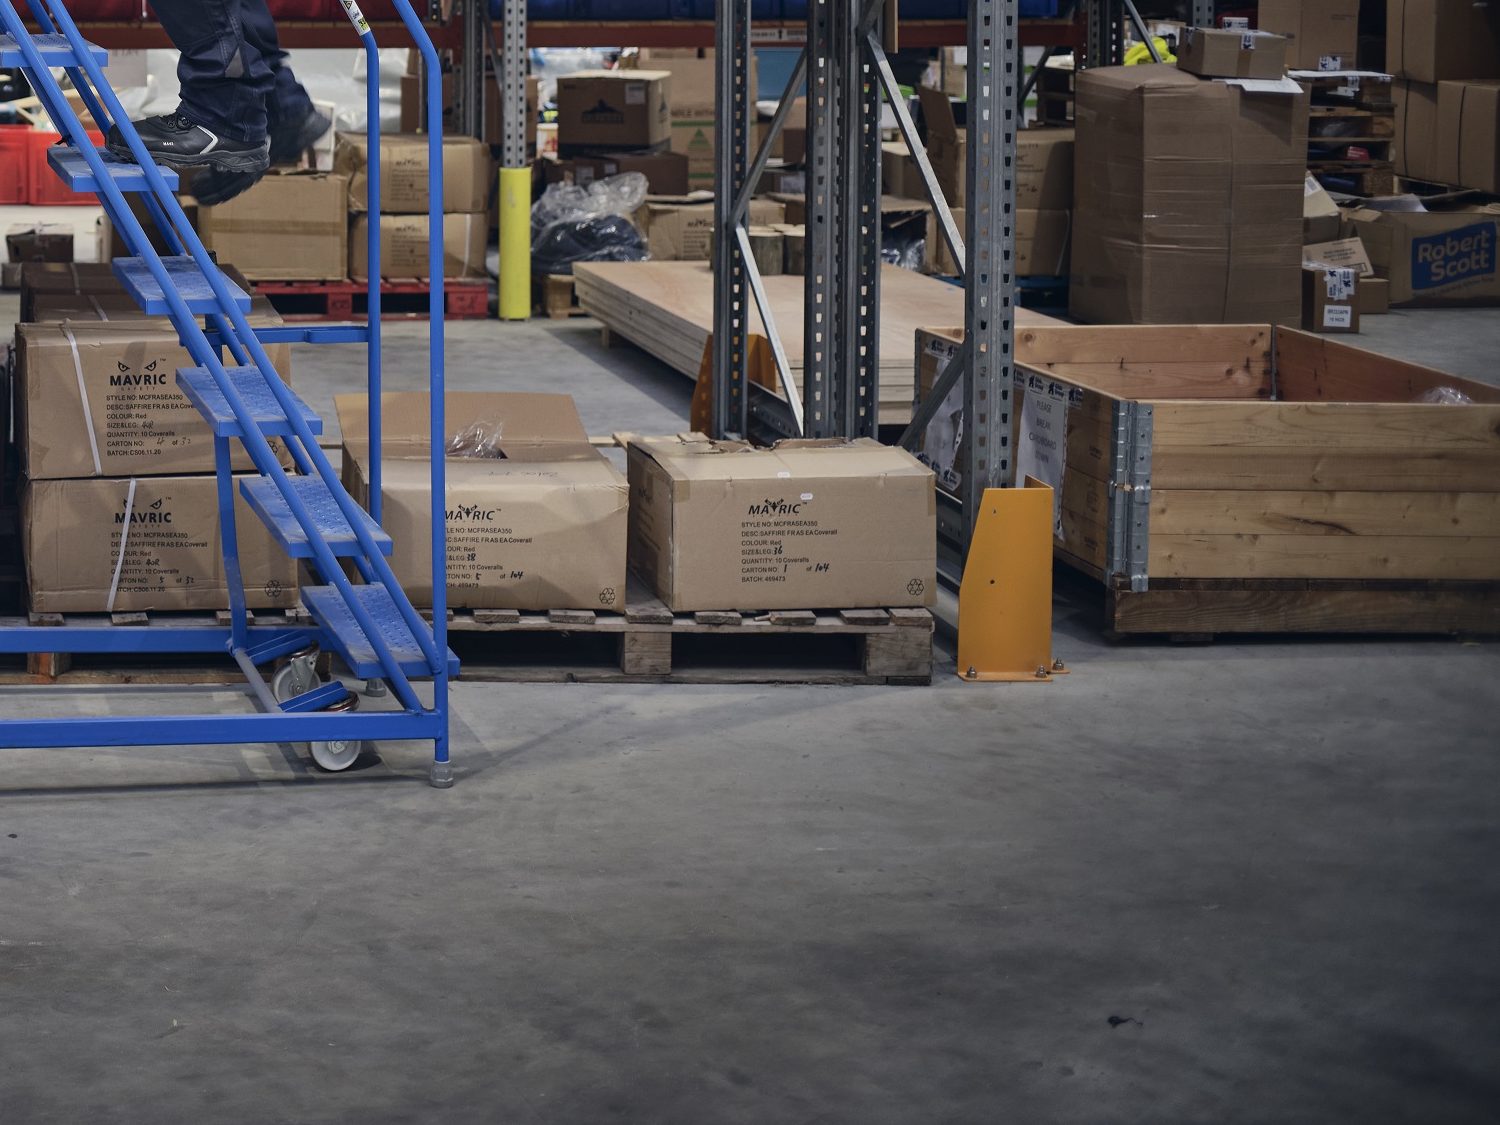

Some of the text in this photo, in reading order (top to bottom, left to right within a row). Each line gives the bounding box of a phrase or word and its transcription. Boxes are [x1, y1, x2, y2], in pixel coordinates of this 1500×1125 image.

[1418, 229, 1490, 263] Robert
[1431, 249, 1489, 281] Scott
[110, 374, 167, 386] MAVRIC
